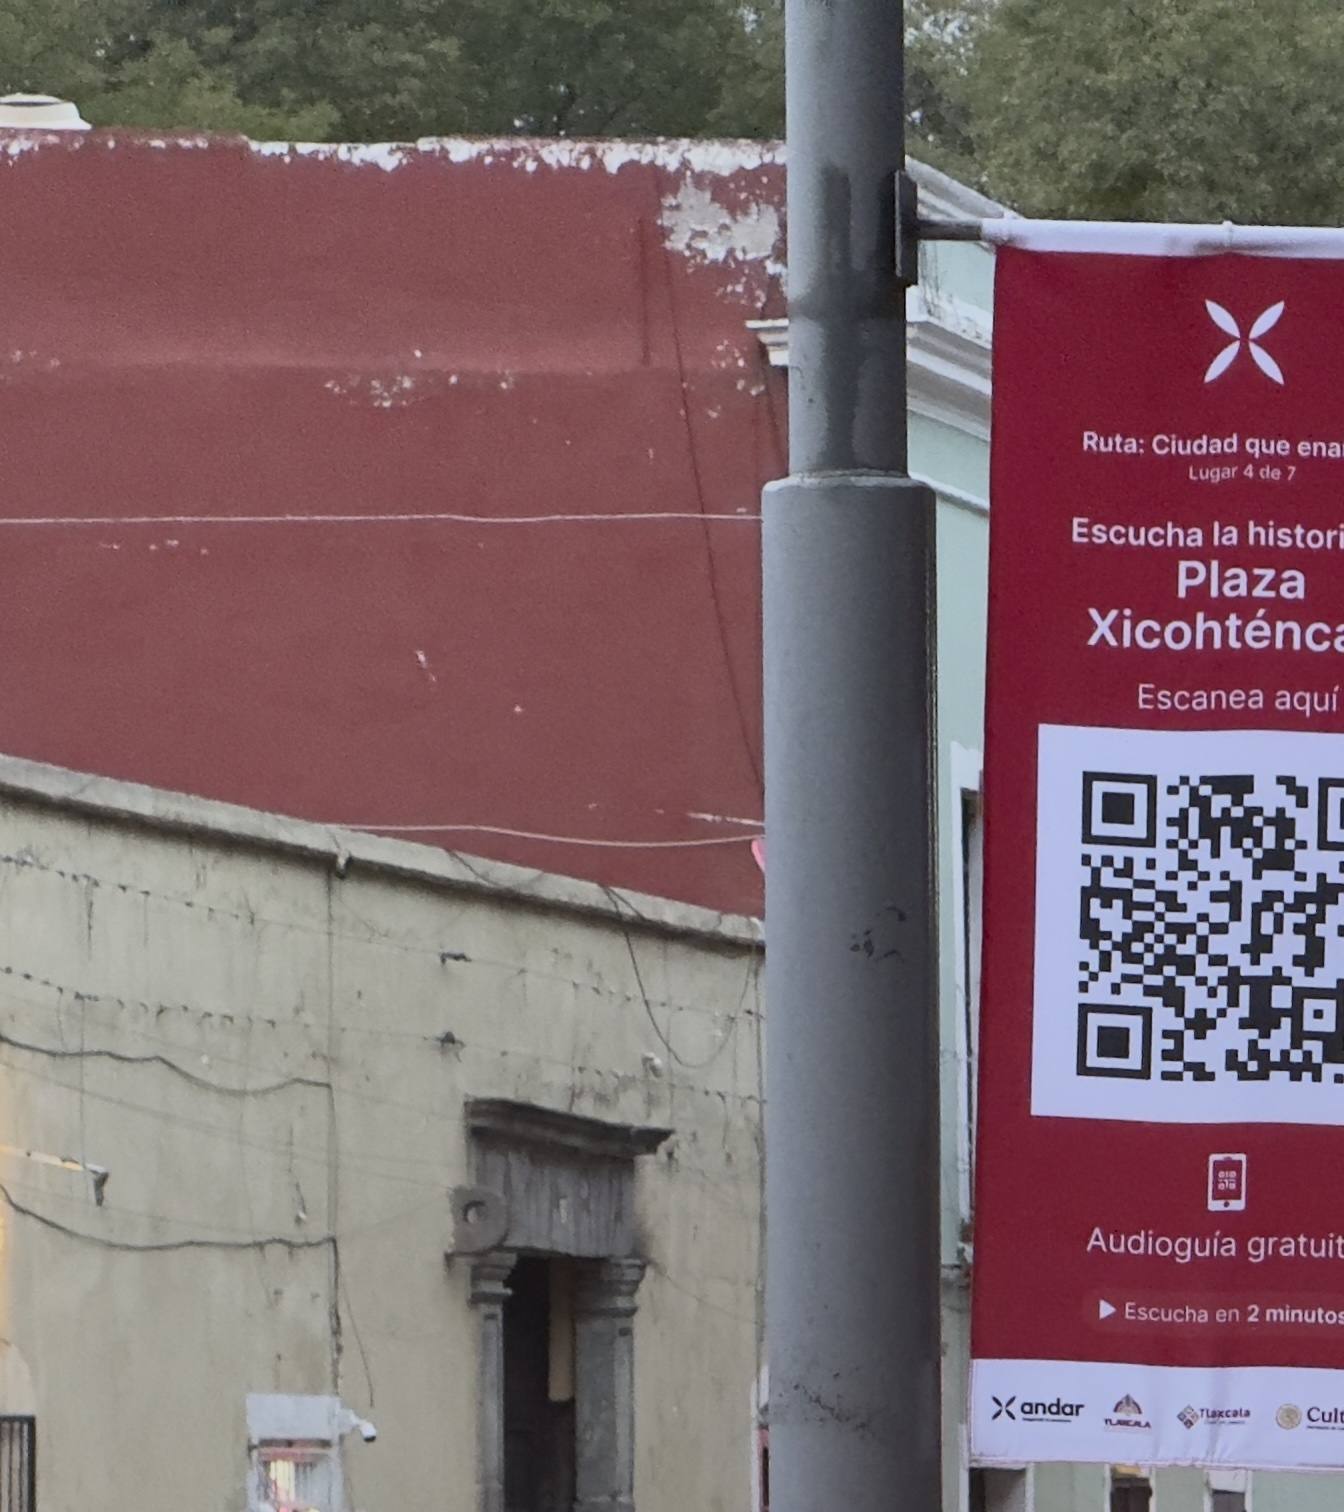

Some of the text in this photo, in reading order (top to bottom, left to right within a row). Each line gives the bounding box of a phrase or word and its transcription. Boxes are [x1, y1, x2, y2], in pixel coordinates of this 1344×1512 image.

[1083, 431, 1144, 453] Ruta:
[1152, 433, 1237, 455] Ciudad
[1245, 438, 1290, 459] que
[1189, 464, 1296, 483] Lugar 4 de 7
[1072, 517, 1202, 547] Escucha
[1214, 521, 1237, 546] la
[1178, 560, 1304, 599] Plaza
[1139, 684, 1339, 717] Escanea aquí
[1087, 1227, 1236, 1263] Audioguía
[1125, 1302, 1208, 1323] Escucha
[1216, 1309, 1239, 1322] en
[1248, 1305, 1259, 1322] 2
[1020, 1397, 1085, 1417] andar
[1199, 1406, 1252, 1420] Tlaxcala
